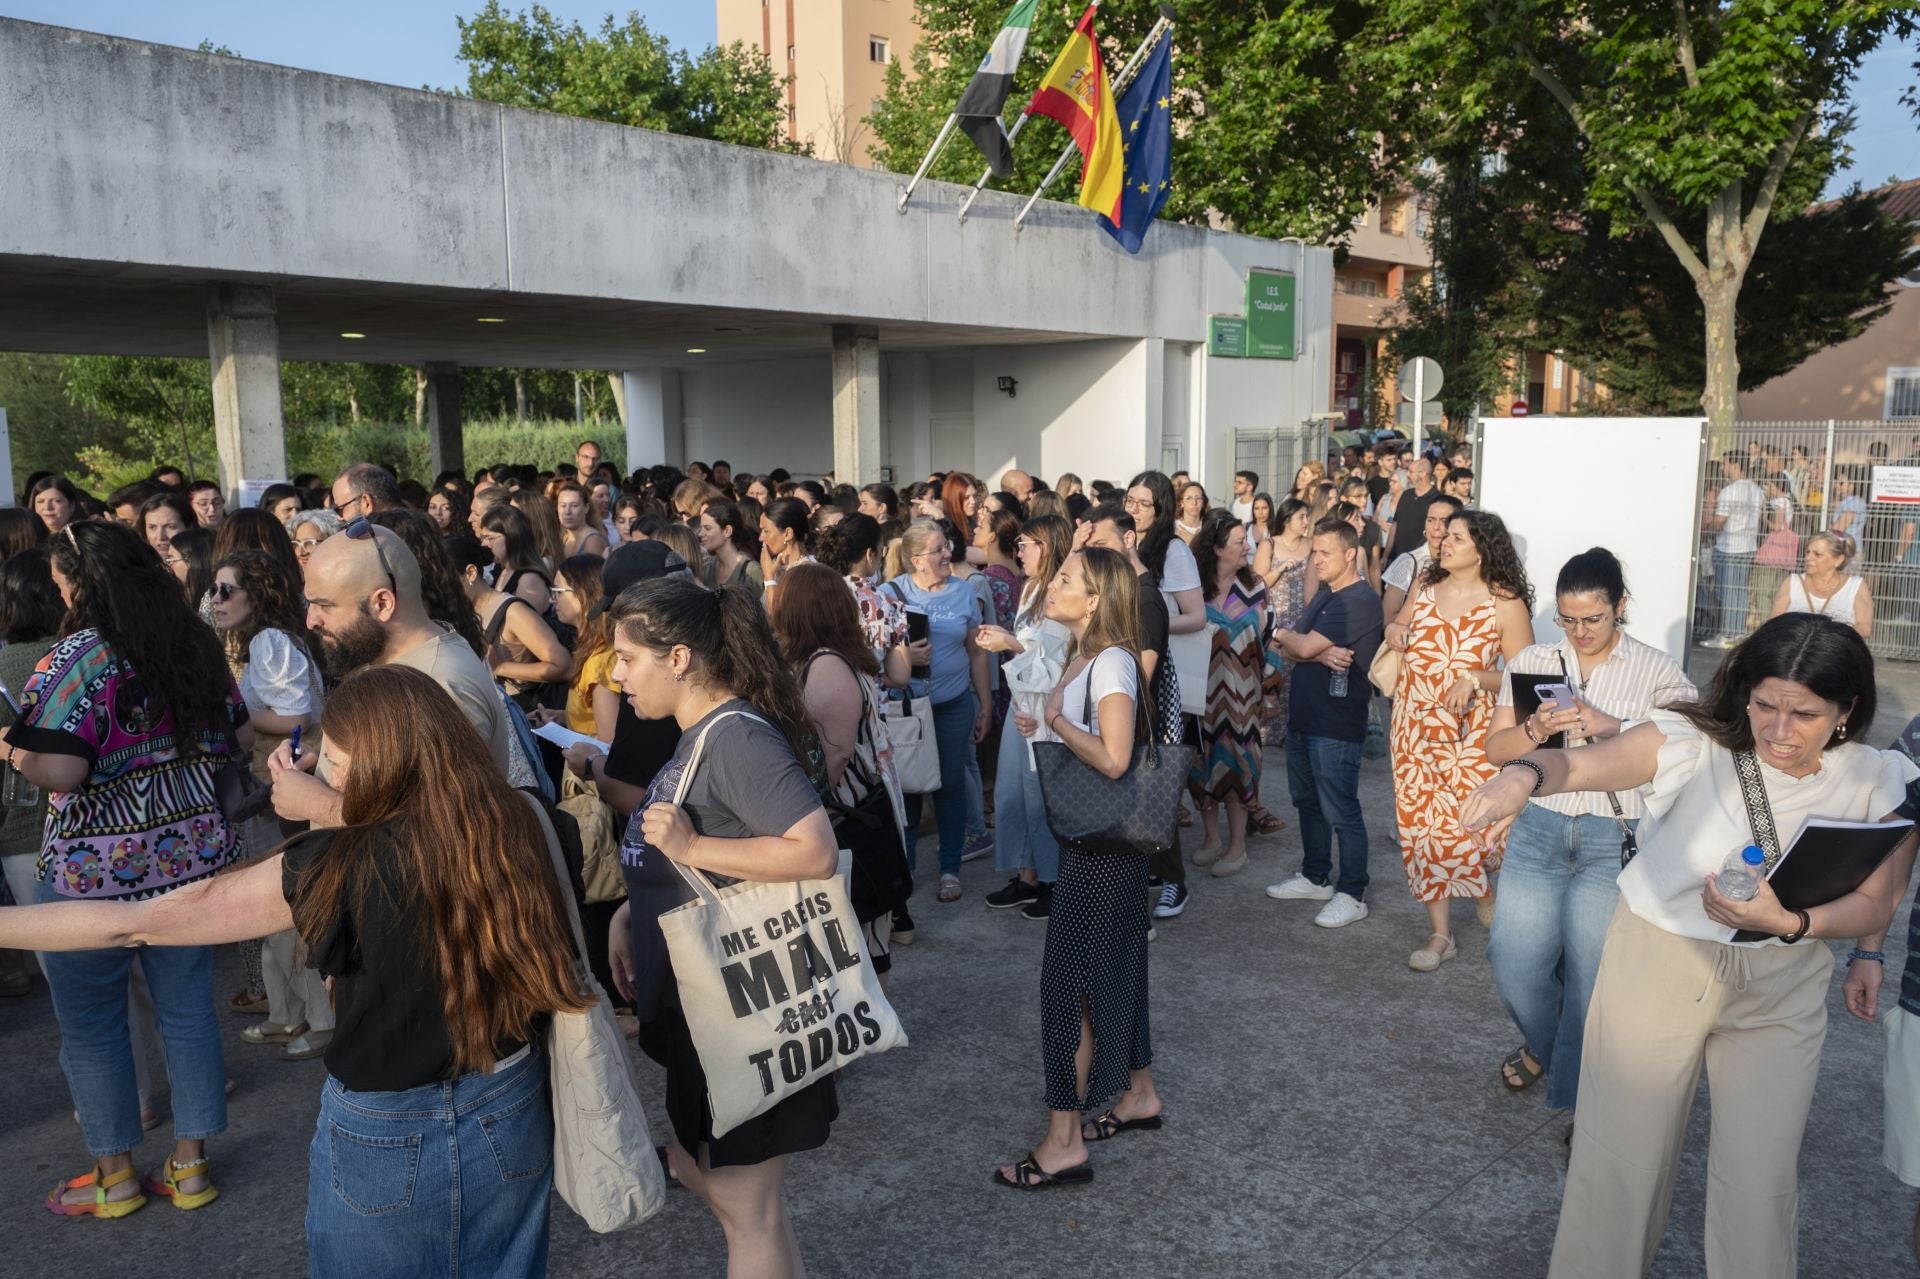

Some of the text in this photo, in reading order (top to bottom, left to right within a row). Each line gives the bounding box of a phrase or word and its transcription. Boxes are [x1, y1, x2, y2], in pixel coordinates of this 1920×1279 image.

[720, 891, 833, 957] ME CAEIS
[720, 917, 861, 1019] MAL
[749, 1000, 882, 1096] TODOS
[781, 988, 836, 1034] CASI
